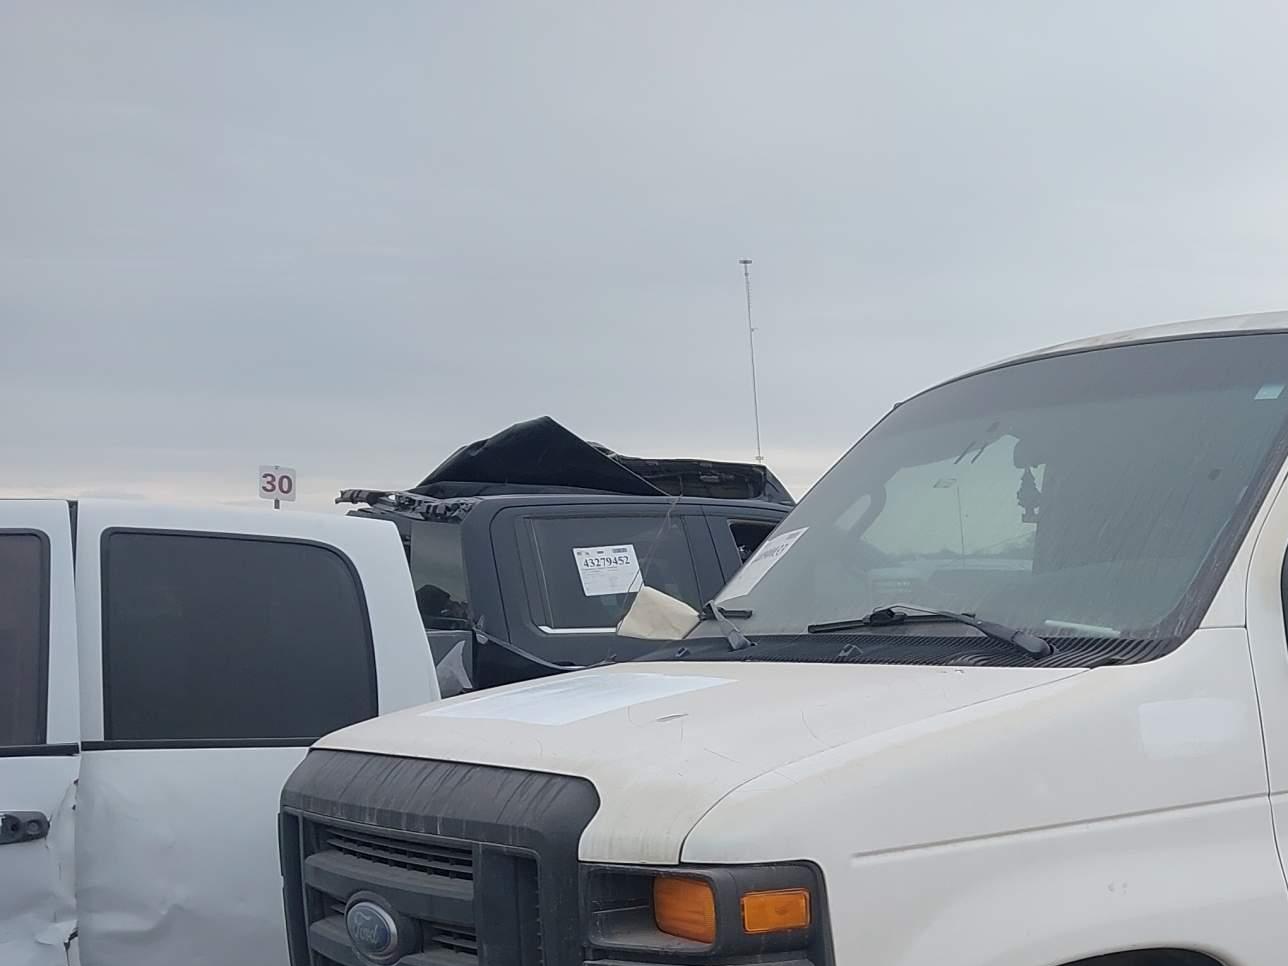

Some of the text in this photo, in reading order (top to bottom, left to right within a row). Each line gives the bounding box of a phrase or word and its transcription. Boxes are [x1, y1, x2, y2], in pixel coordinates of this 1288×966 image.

[261, 473, 293, 495] 30
[583, 555, 631, 568] 43279452
[354, 911, 379, 945] Ford
